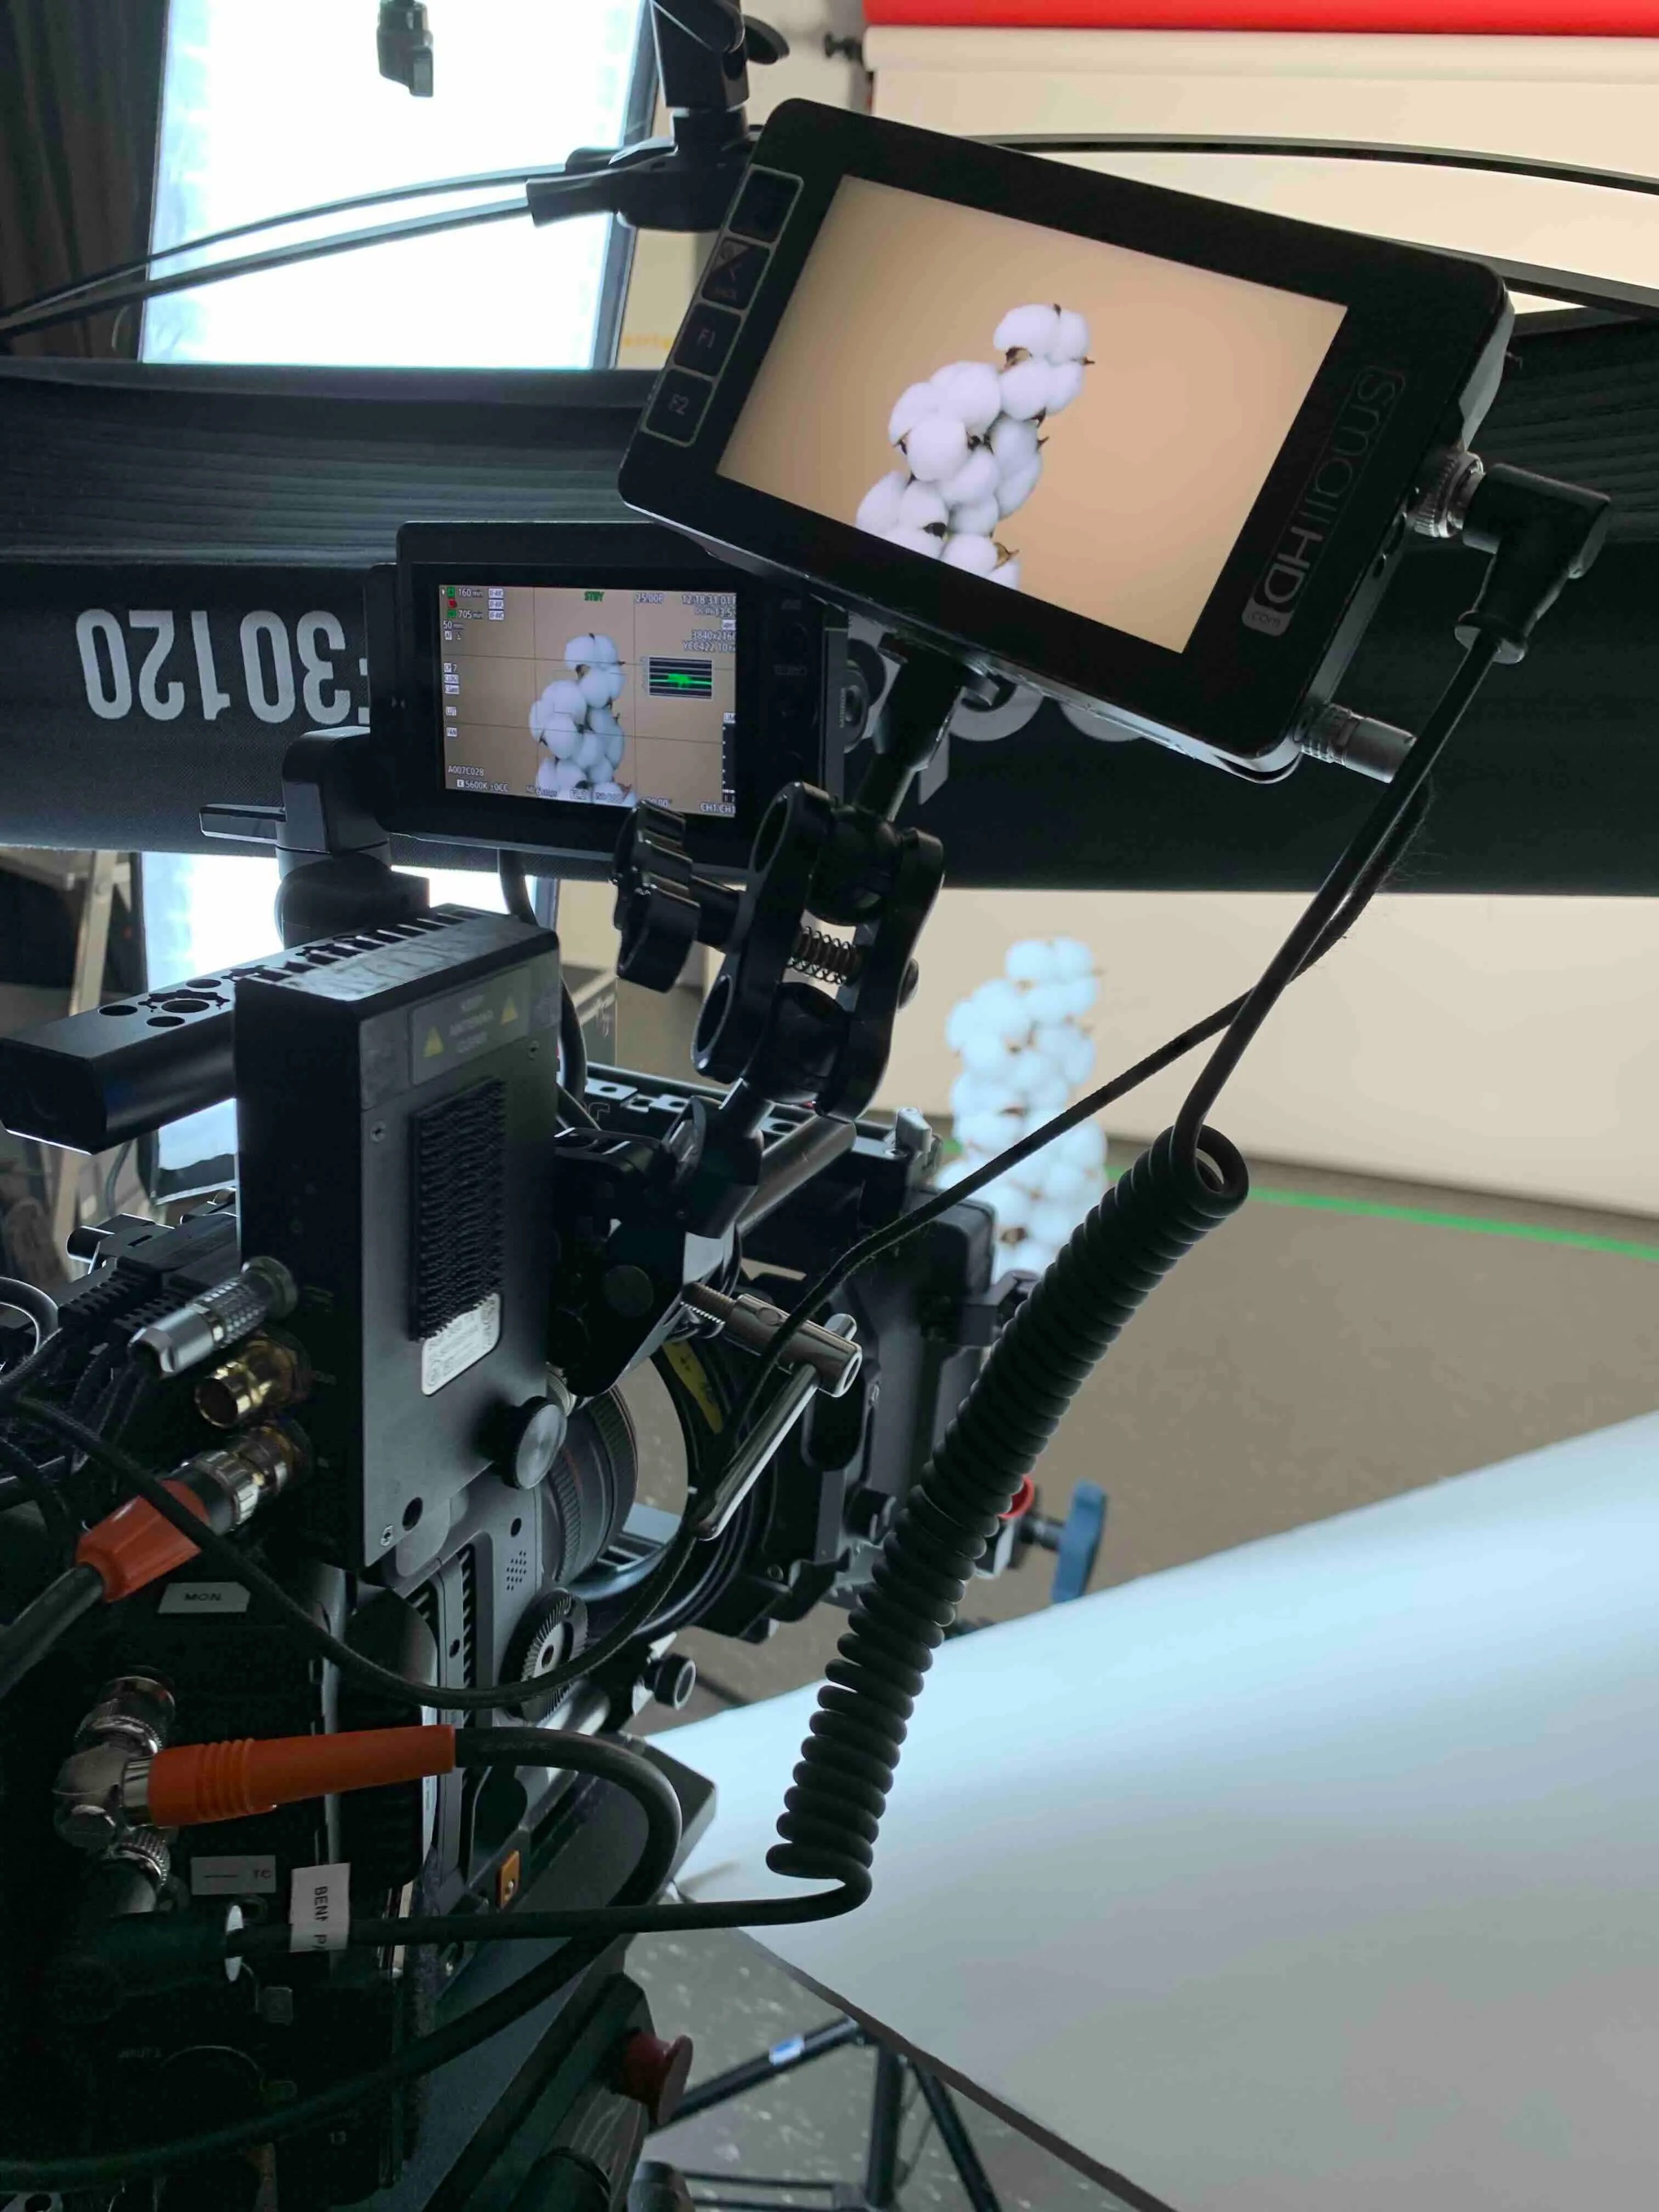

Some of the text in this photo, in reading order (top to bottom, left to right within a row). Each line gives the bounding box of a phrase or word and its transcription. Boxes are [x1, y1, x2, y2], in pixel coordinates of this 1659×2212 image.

[1264, 374, 1397, 603] smallHD
[459, 589, 471, 597] 160
[584, 591, 605, 602] STBY
[459, 610, 472, 619] 705
[443, 620, 452, 629] 50
[448, 765, 484, 777] A007C028
[465, 780, 488, 790] 5600K
